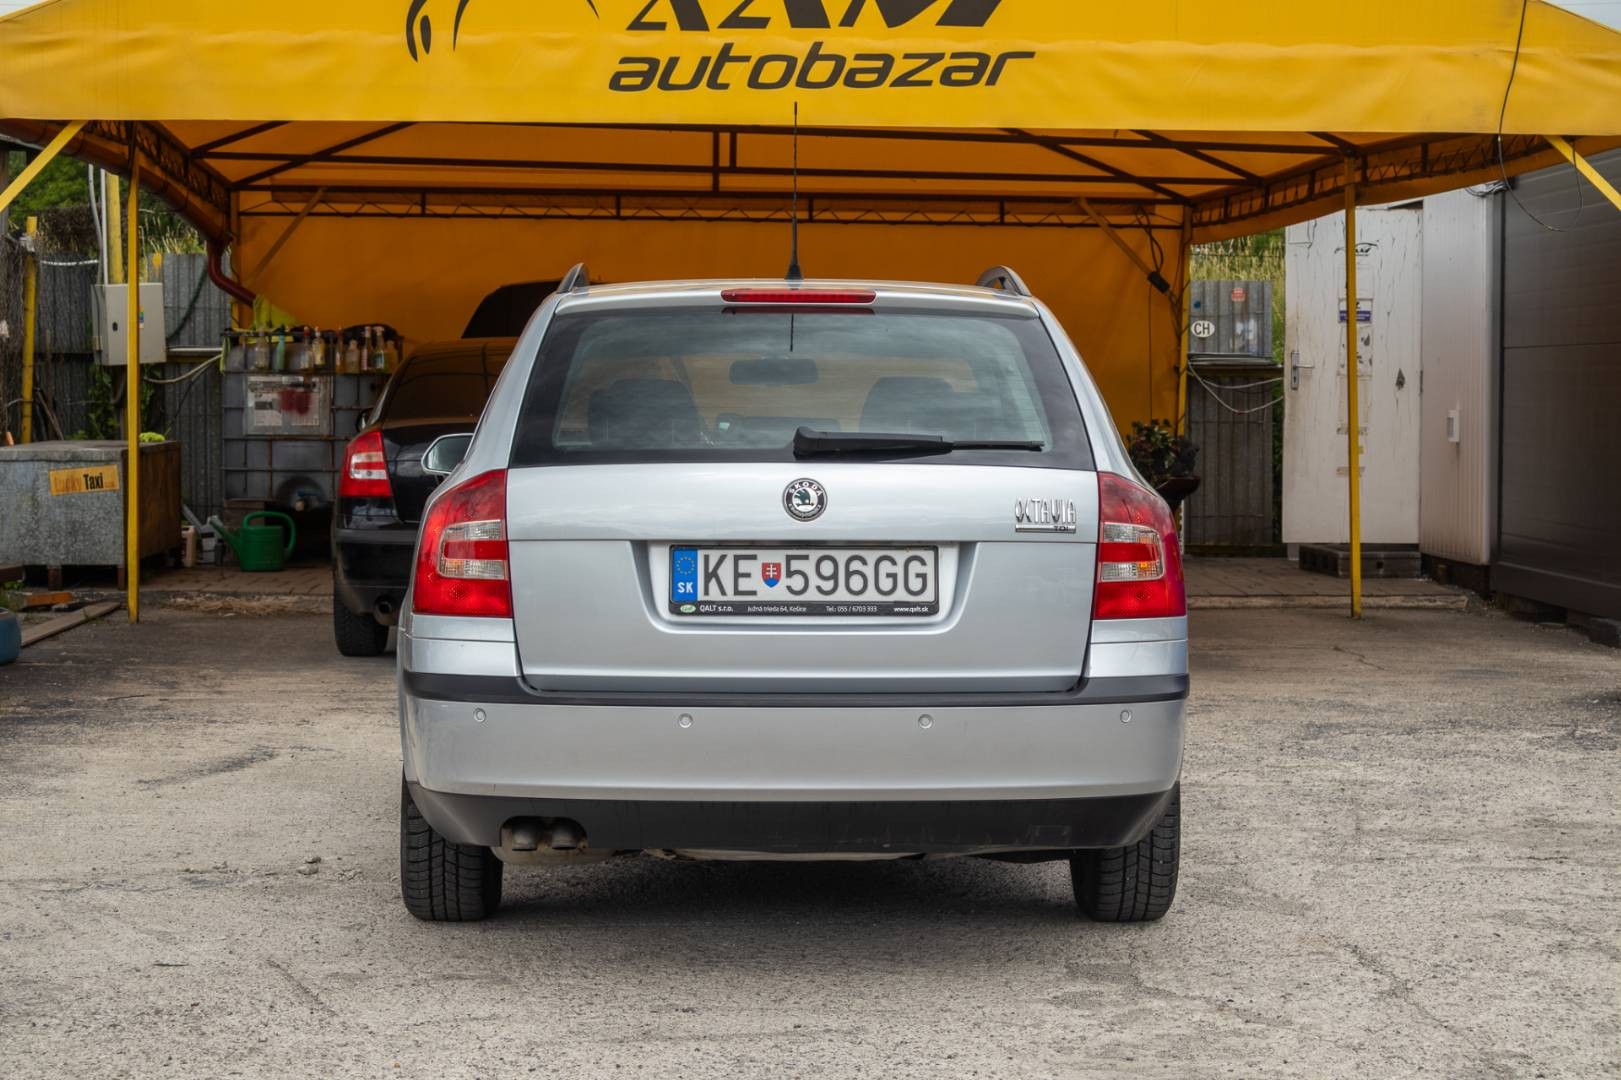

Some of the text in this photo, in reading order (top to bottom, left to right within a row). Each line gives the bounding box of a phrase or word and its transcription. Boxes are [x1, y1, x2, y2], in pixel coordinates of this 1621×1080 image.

[608, 41, 1036, 91] autobazar
[1194, 322, 1210, 335] CH
[83, 472, 104, 490] Taxi
[1015, 498, 1076, 523] OCTAVIA
[703, 554, 928, 596] KE 596GG
[677, 582, 694, 593] SK
[700, 605, 716, 613] QALT
[717, 605, 734, 613] s.r.o.
